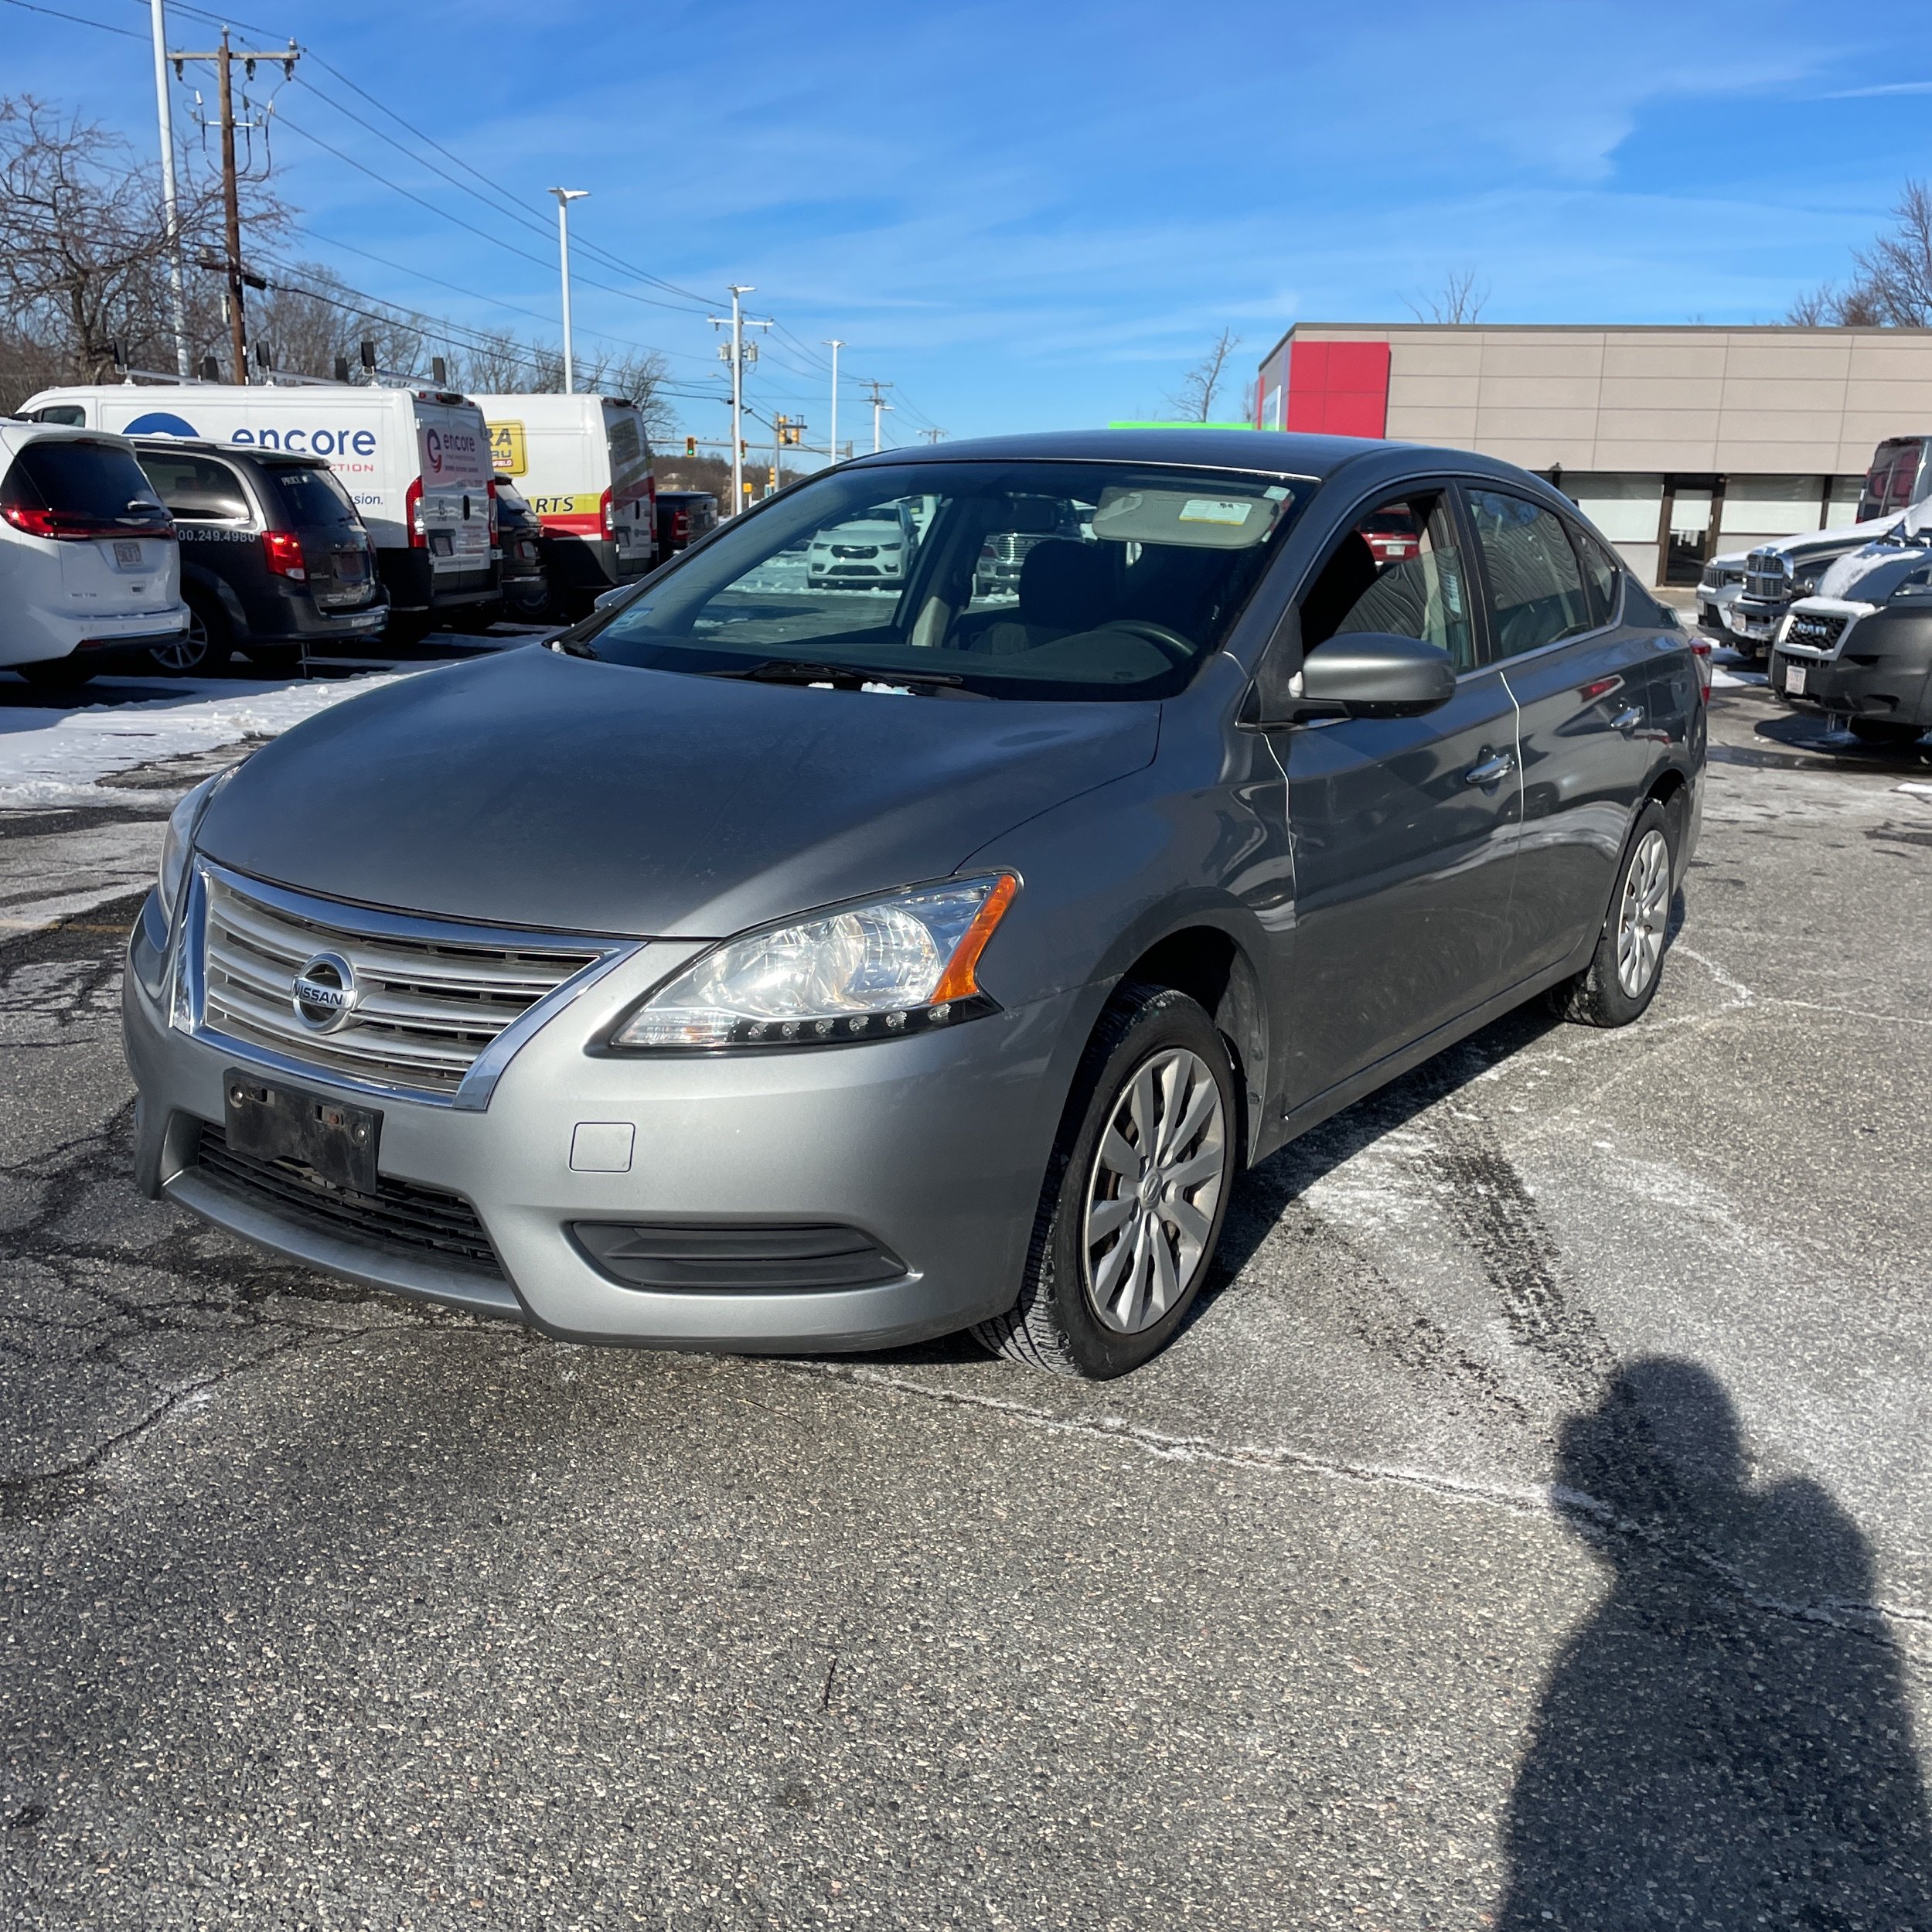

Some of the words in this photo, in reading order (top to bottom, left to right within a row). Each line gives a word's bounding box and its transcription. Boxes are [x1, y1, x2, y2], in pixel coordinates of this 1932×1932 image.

[231, 428, 377, 456] encore
[443, 434, 475, 452] encore
[293, 983, 343, 1005] NISSAN
